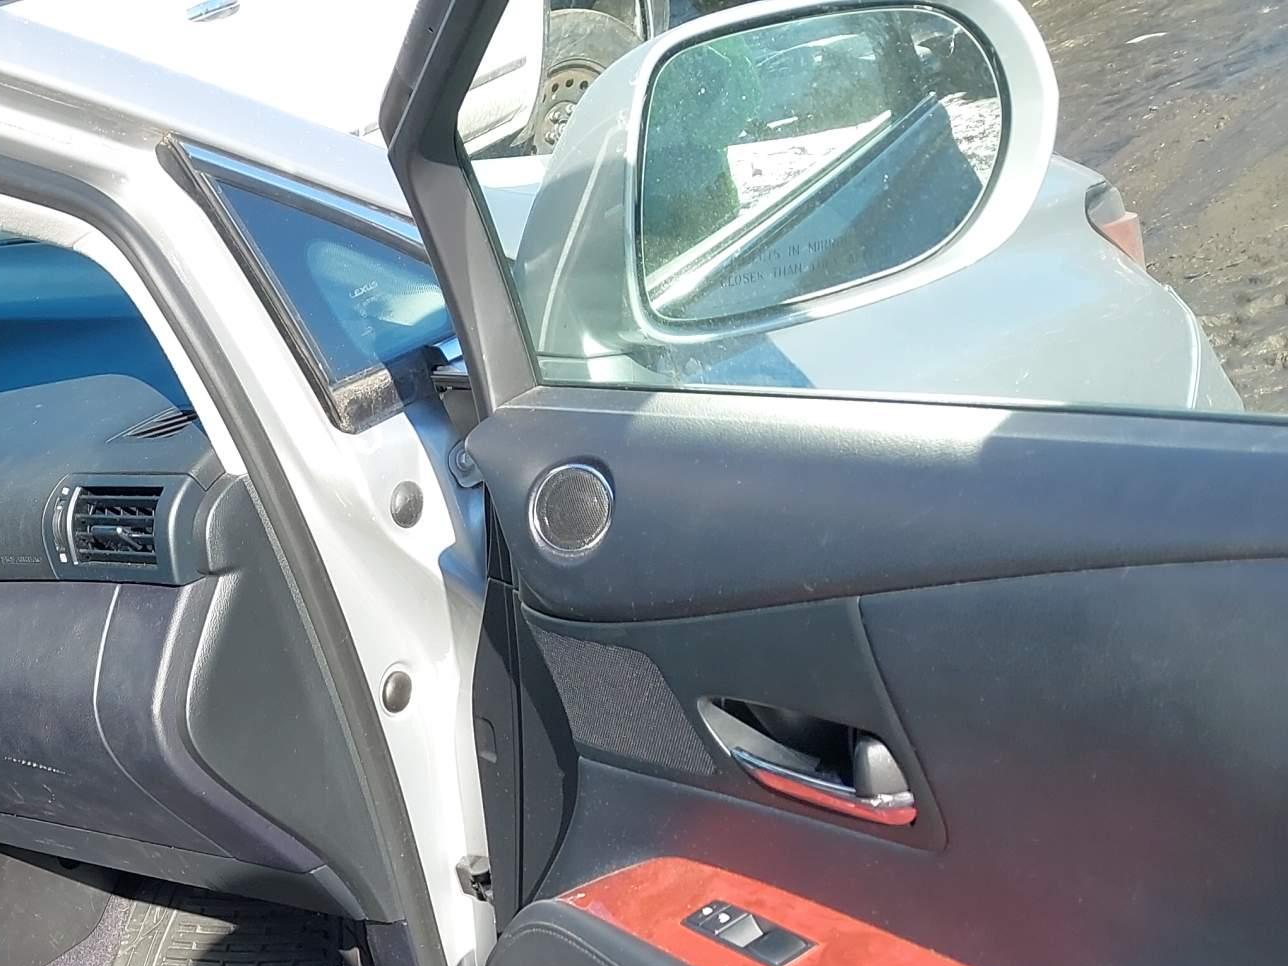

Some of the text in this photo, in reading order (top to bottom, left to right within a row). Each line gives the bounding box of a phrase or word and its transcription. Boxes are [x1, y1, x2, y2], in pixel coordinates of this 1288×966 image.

[787, 244, 801, 258] IN
[719, 272, 765, 289] CLOSER
[772, 263, 804, 279] THAN
